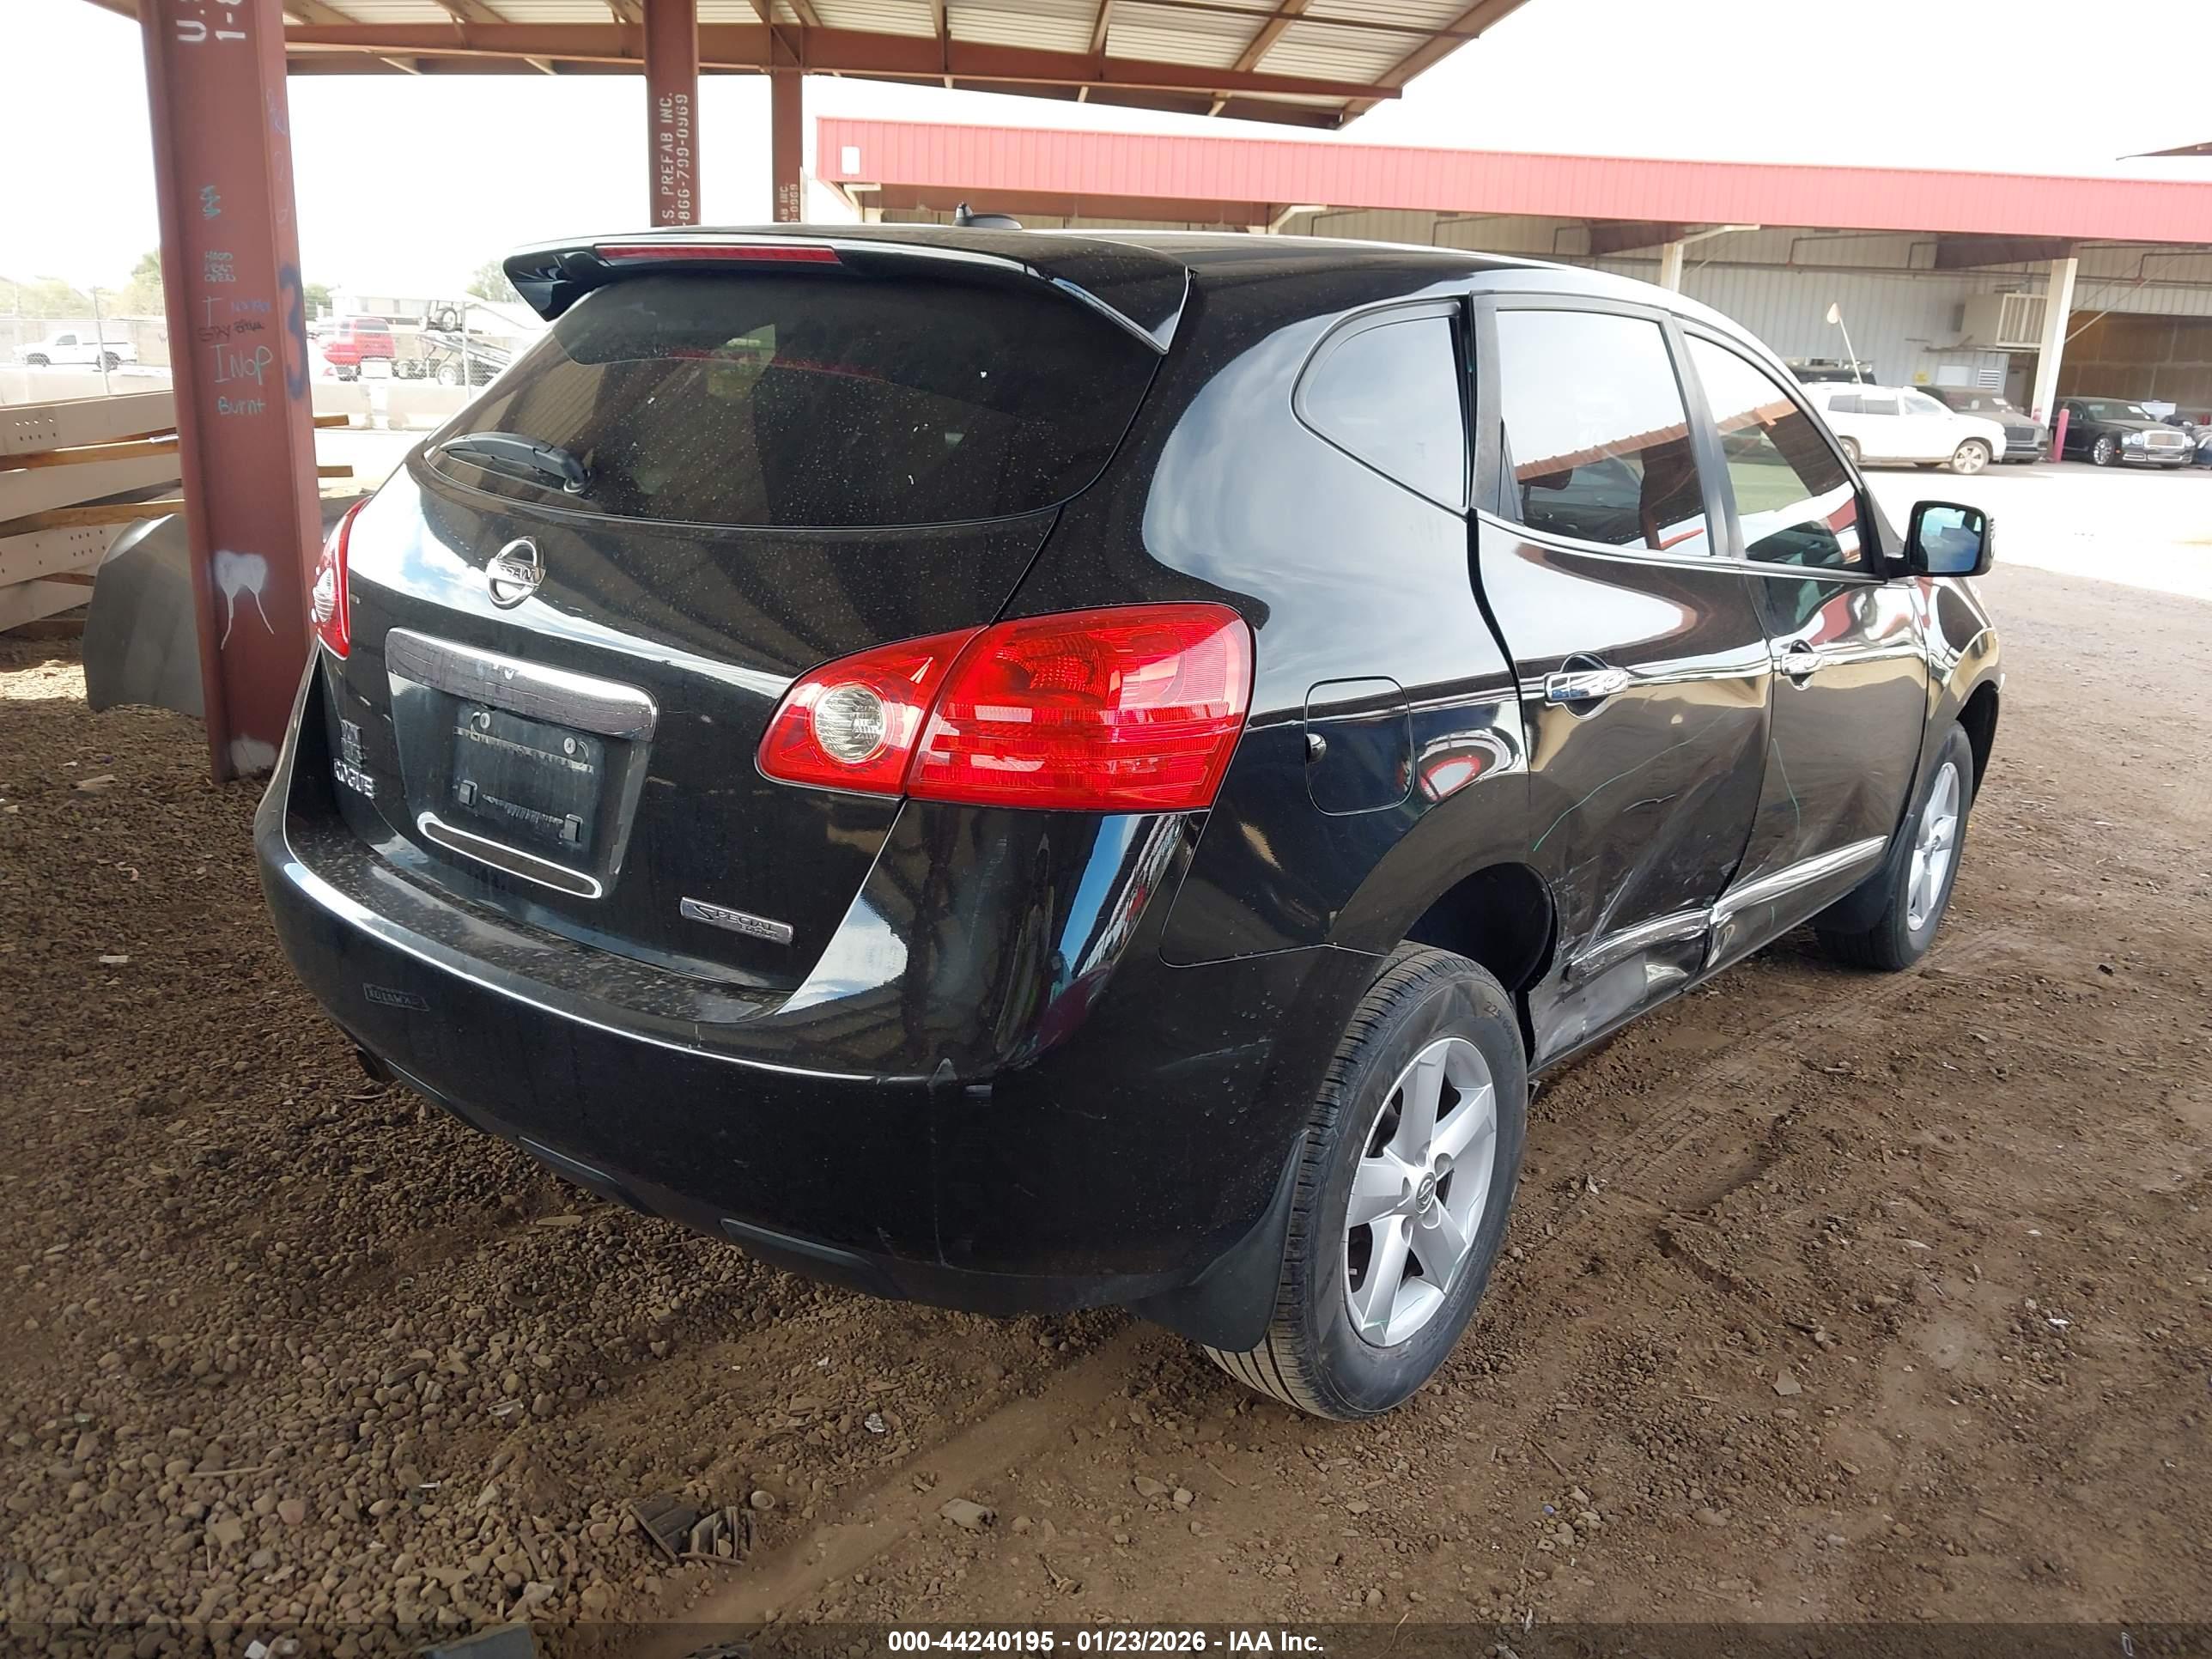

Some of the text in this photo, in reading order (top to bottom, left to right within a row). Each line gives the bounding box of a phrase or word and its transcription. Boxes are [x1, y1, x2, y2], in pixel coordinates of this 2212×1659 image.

[659, 92, 673, 124] INC.
[659, 131, 675, 196] PREFAB
[692, 904, 777, 933] SPECIAL
